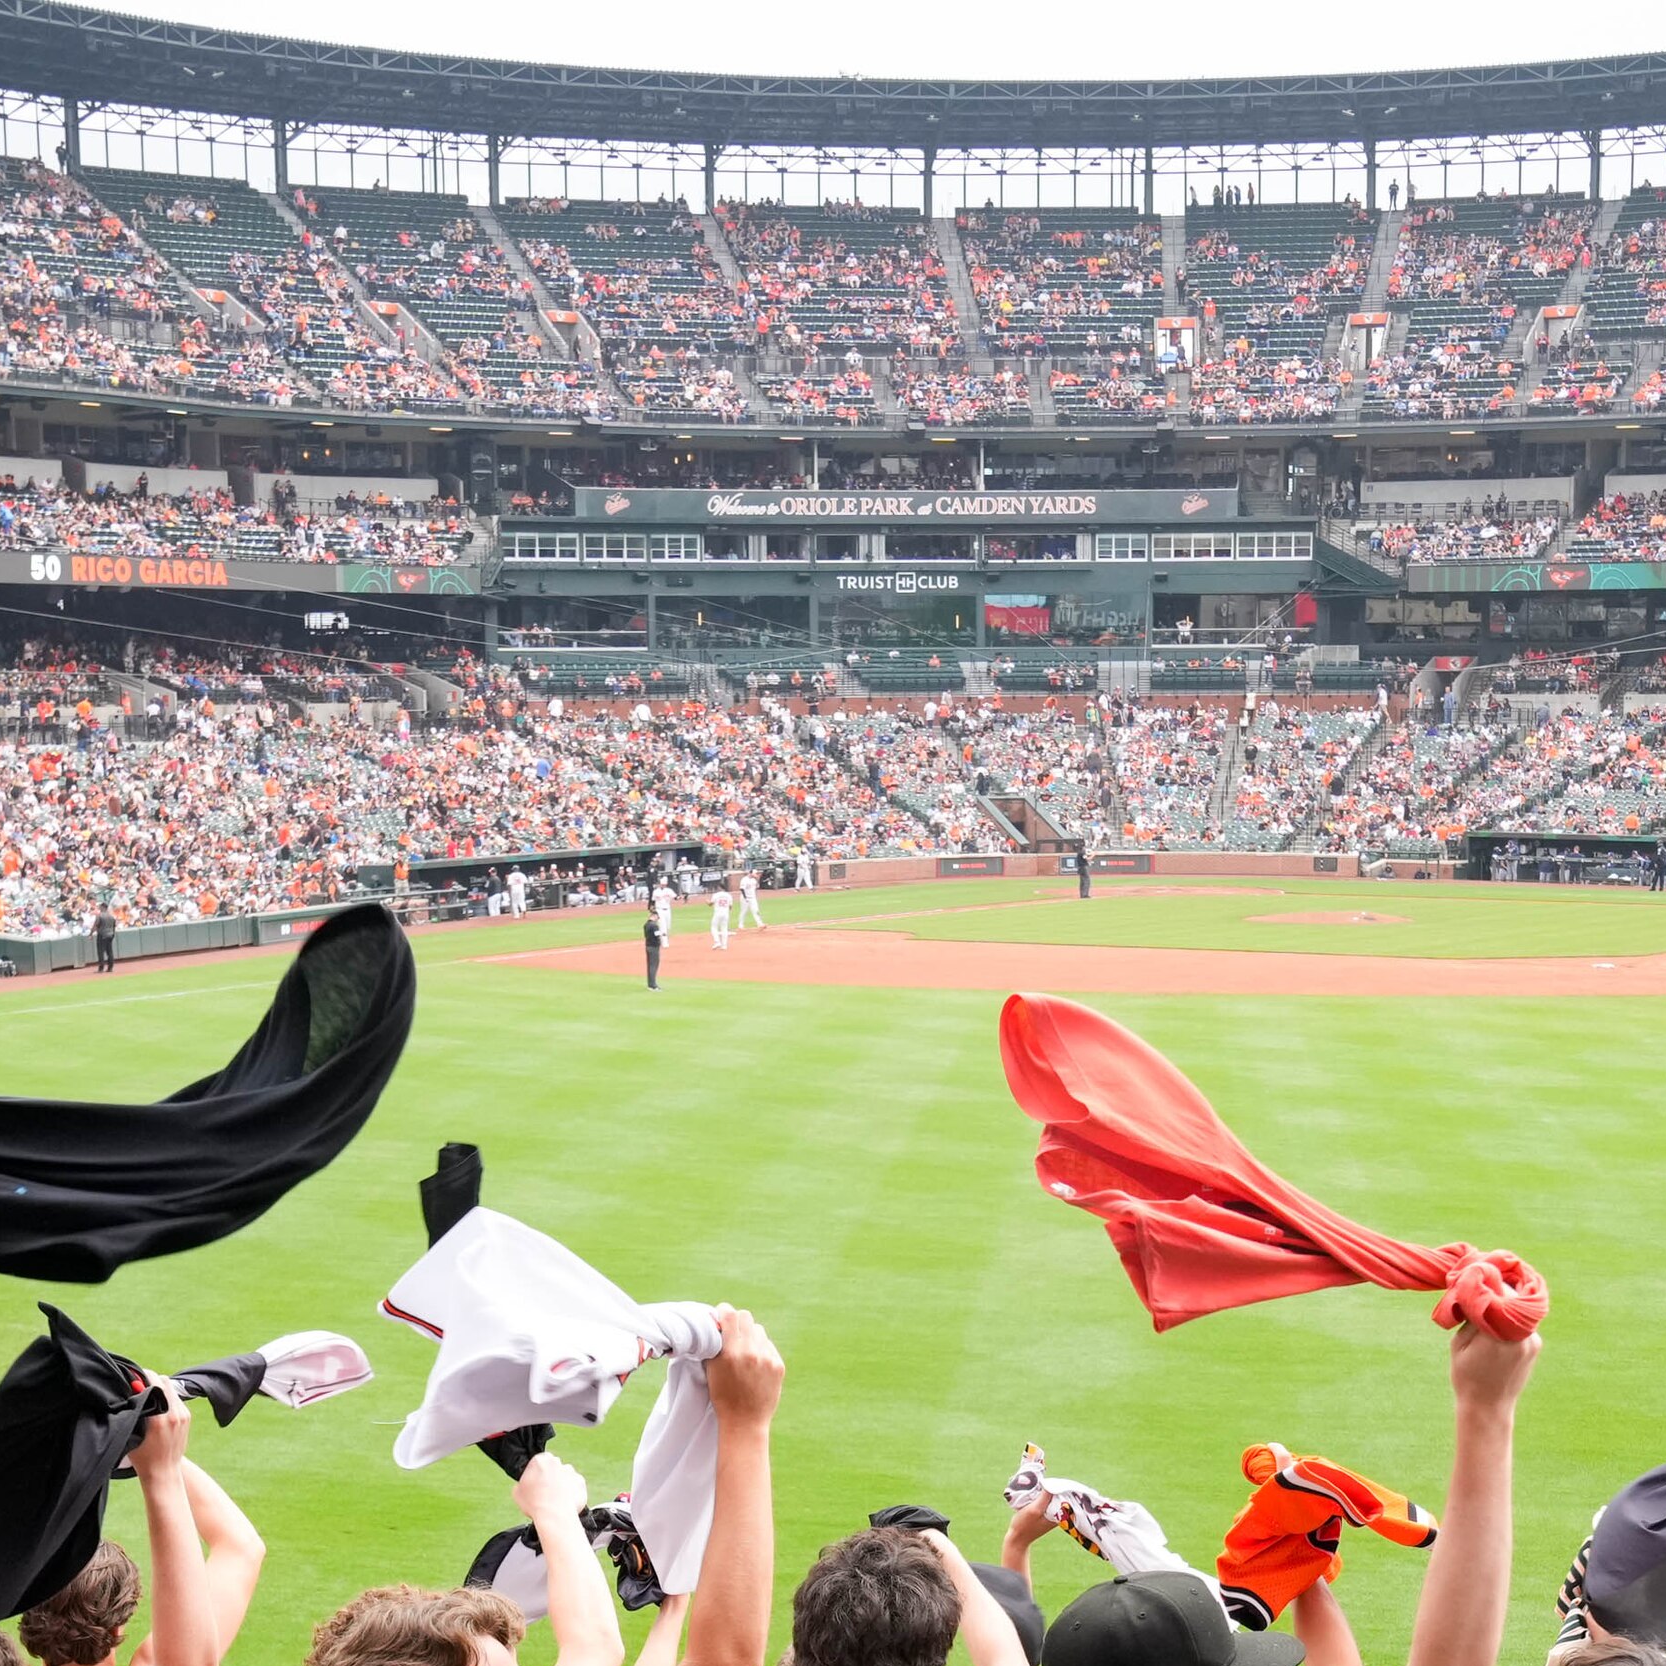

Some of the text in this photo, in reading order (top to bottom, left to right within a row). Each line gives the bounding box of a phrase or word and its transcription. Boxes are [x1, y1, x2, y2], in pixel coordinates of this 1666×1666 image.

[707, 493, 764, 517] Welcome
[766, 501, 780, 516] to
[780, 497, 858, 516] ORIOLE
[860, 497, 915, 516] PARK
[935, 496, 1026, 516] CAMDEN
[1027, 496, 1096, 515] YARDS
[30, 554, 228, 586] 50 RICO GARCIA
[836, 575, 959, 590] TRUIST CLUB
